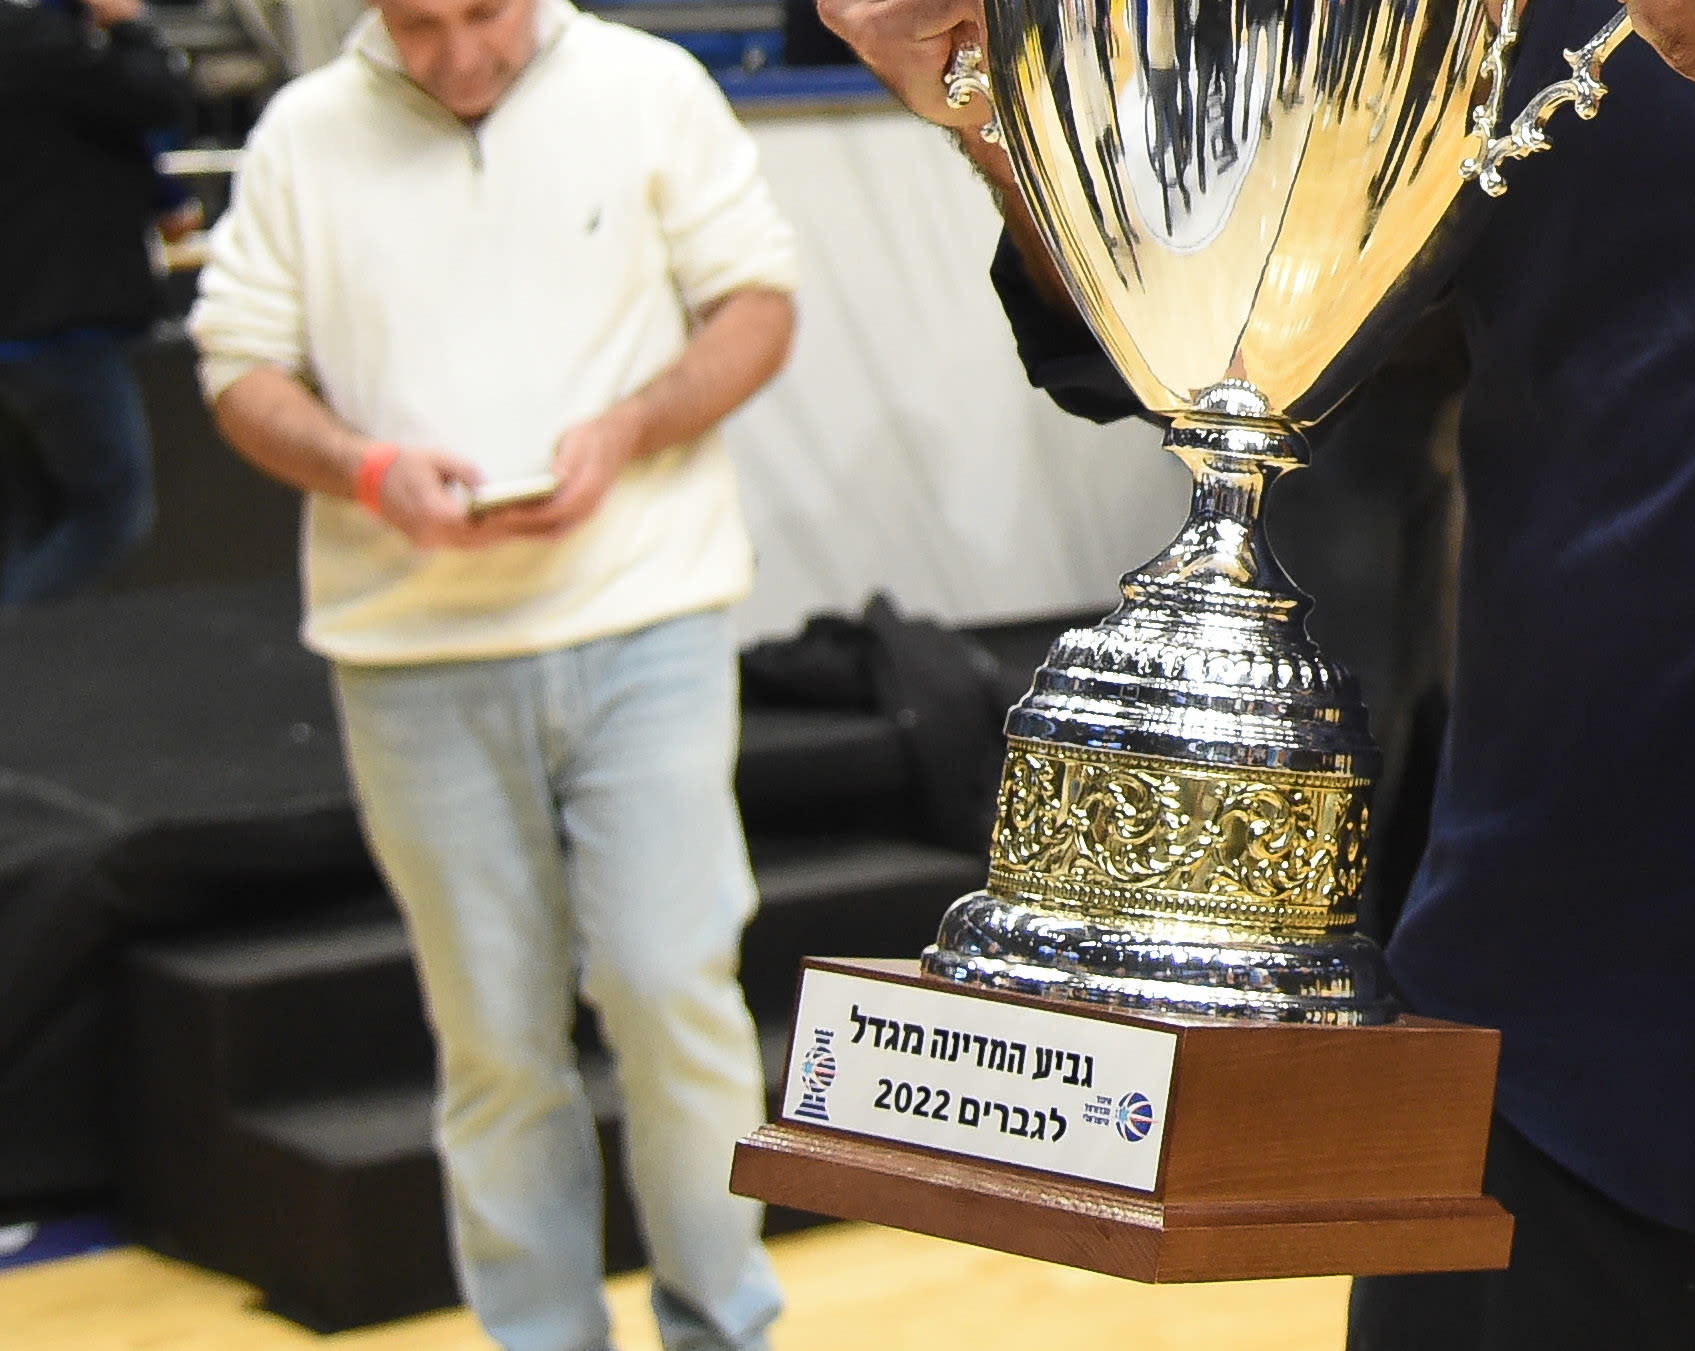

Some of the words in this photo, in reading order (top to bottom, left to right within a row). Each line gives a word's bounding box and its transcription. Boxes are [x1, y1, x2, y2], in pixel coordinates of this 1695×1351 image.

[850, 1004, 925, 1056] מגדל
[930, 1027, 1027, 1075] המדינה
[1032, 1047, 1094, 1088] גביע
[873, 1078, 951, 1122] 2022
[958, 1096, 1068, 1143] לגברים
